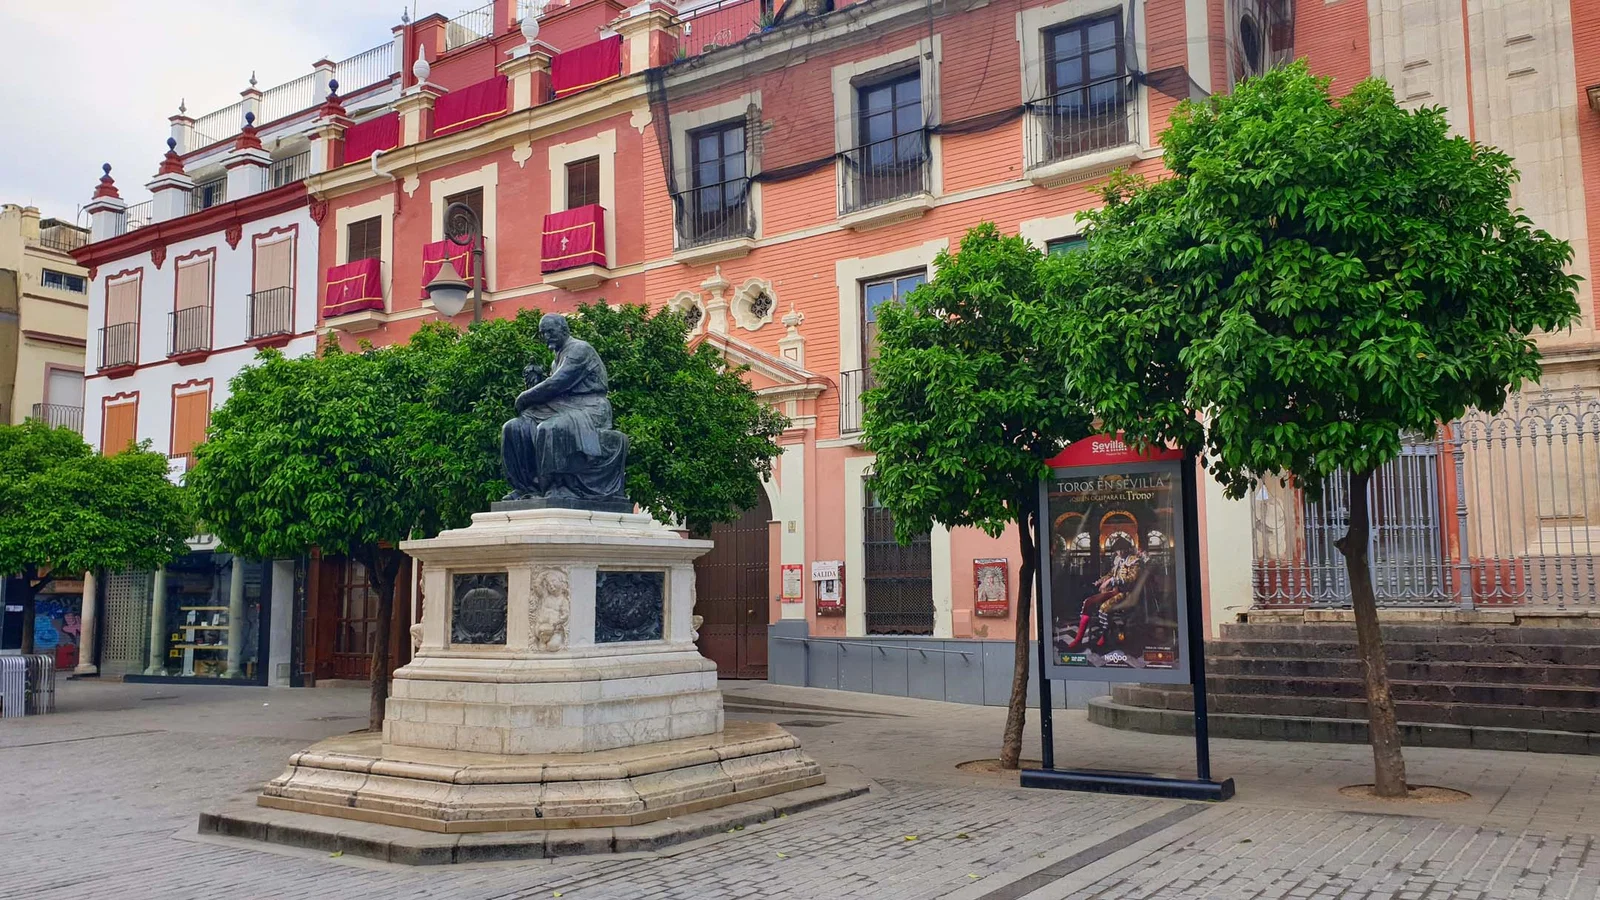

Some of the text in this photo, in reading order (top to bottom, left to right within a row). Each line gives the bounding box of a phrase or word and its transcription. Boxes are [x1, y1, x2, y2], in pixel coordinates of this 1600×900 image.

[1057, 477, 1165, 493] TOROS EN SEVILLA
